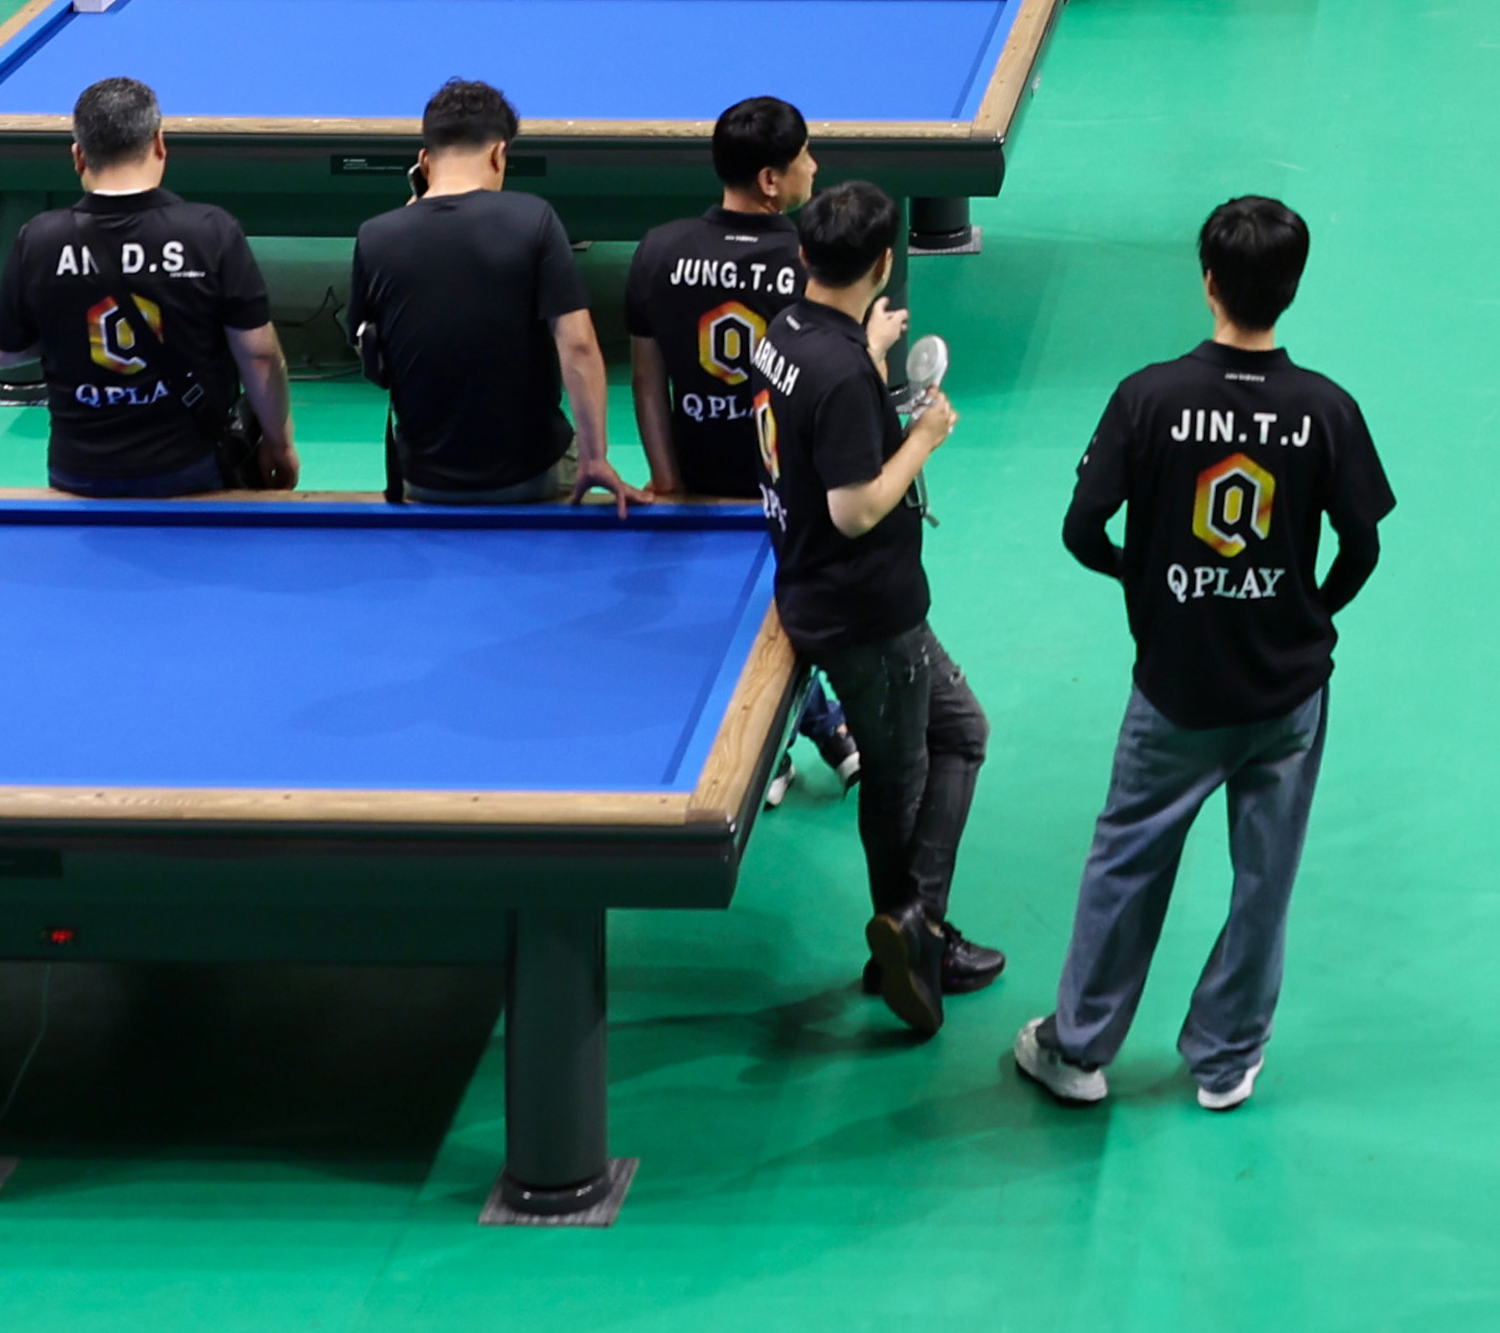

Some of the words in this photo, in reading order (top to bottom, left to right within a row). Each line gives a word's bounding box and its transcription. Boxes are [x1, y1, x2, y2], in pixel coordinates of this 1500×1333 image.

[670, 258, 795, 295] JUNG.T.G
[1170, 408, 1311, 448] JIN.T.J
[1167, 563, 1285, 604] QPLAY
